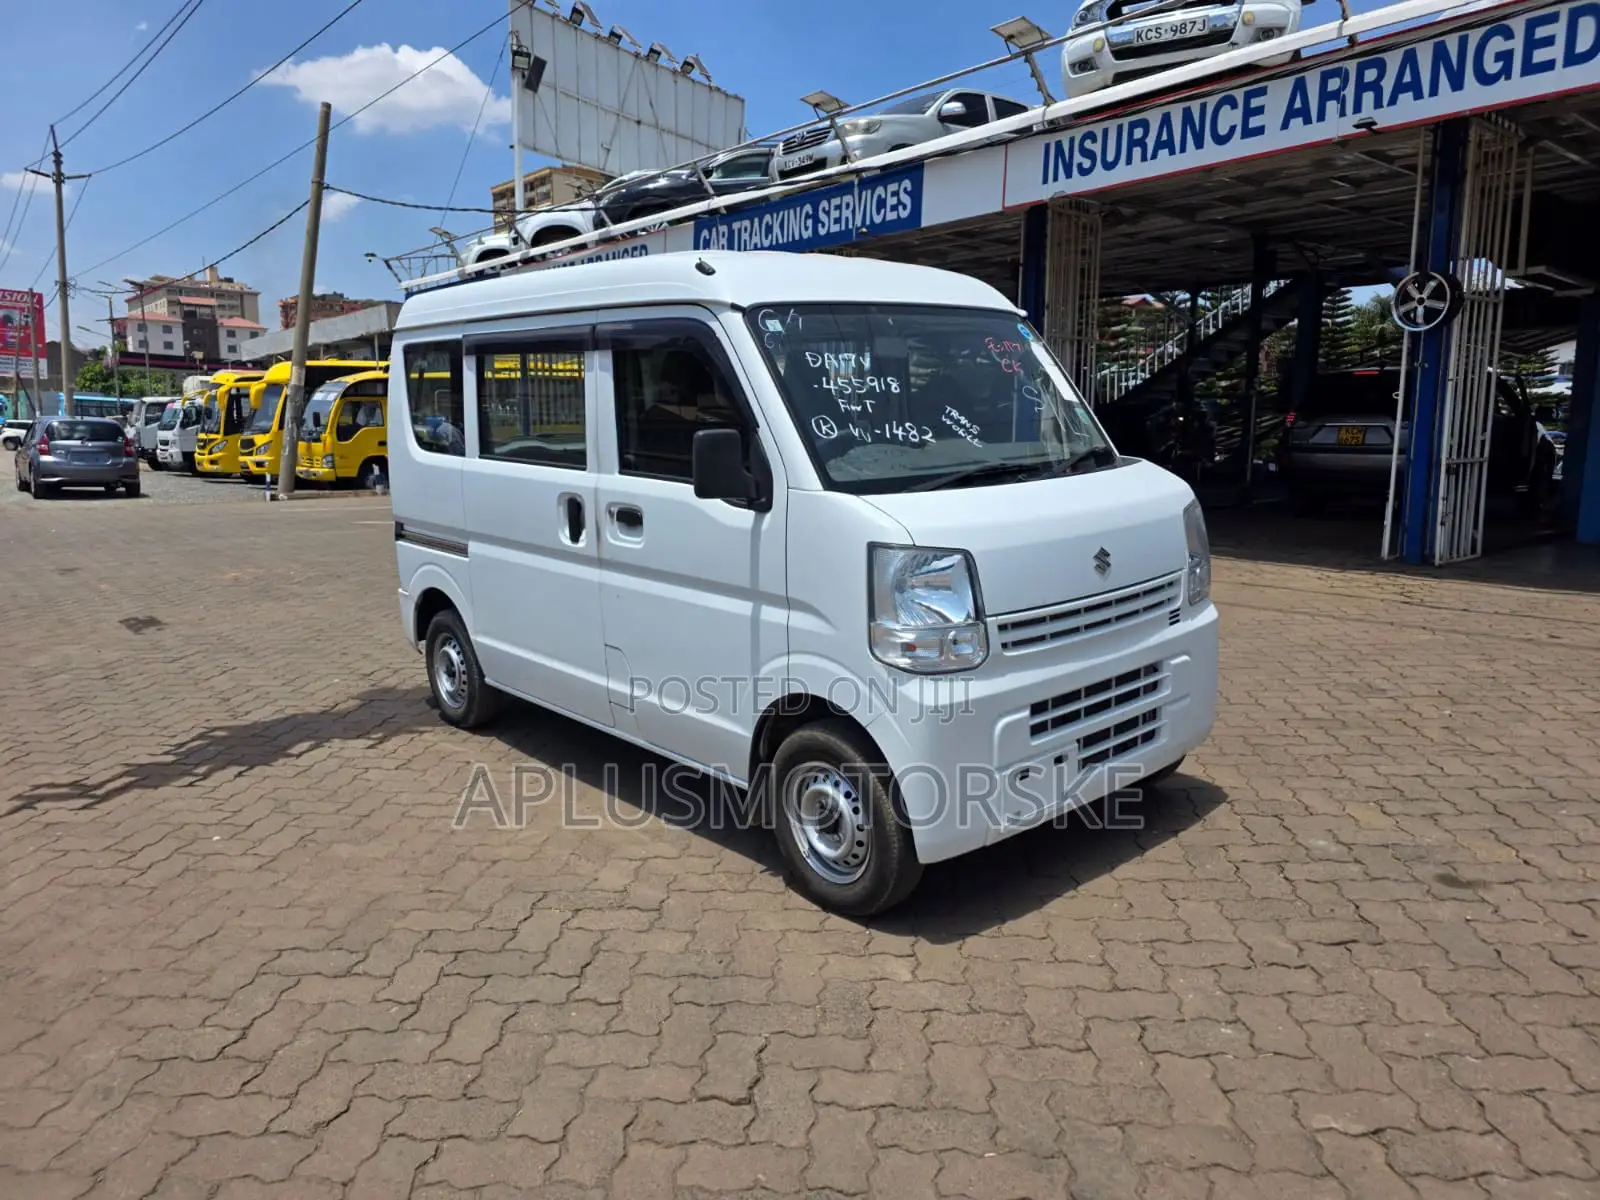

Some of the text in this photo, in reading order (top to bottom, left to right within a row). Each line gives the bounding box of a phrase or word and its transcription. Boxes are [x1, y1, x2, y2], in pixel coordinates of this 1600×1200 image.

[1135, 20, 1207, 43] KCS 987J
[1042, 2, 1600, 184] INSURANCE ARRANGED
[701, 178, 912, 250] CAR TRACKING SERVICES
